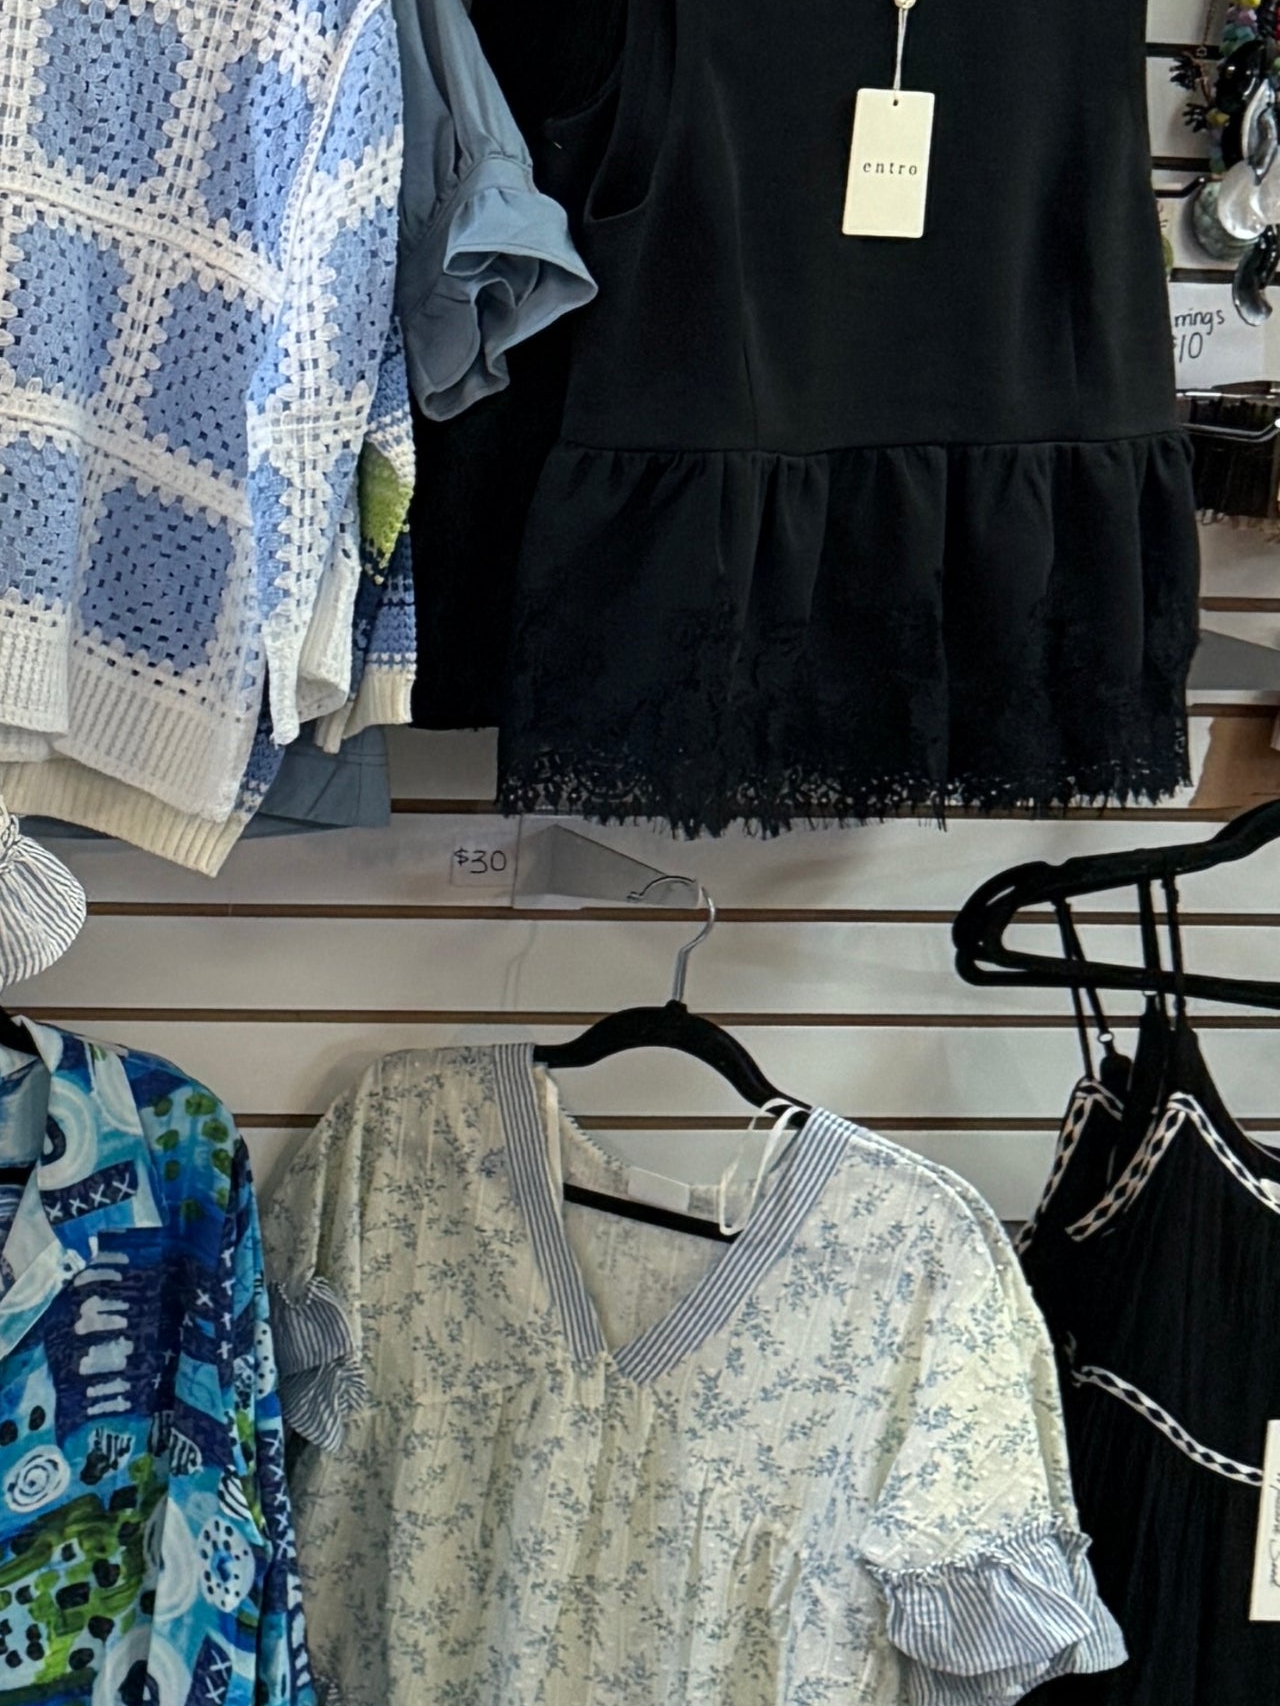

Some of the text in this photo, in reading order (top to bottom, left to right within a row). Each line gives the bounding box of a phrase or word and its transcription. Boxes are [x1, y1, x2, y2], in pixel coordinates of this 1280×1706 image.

[863, 162, 918, 176] entro
[1174, 307, 1225, 336] rrings
[1172, 332, 1203, 363] 10
[454, 847, 507, 874] $30
